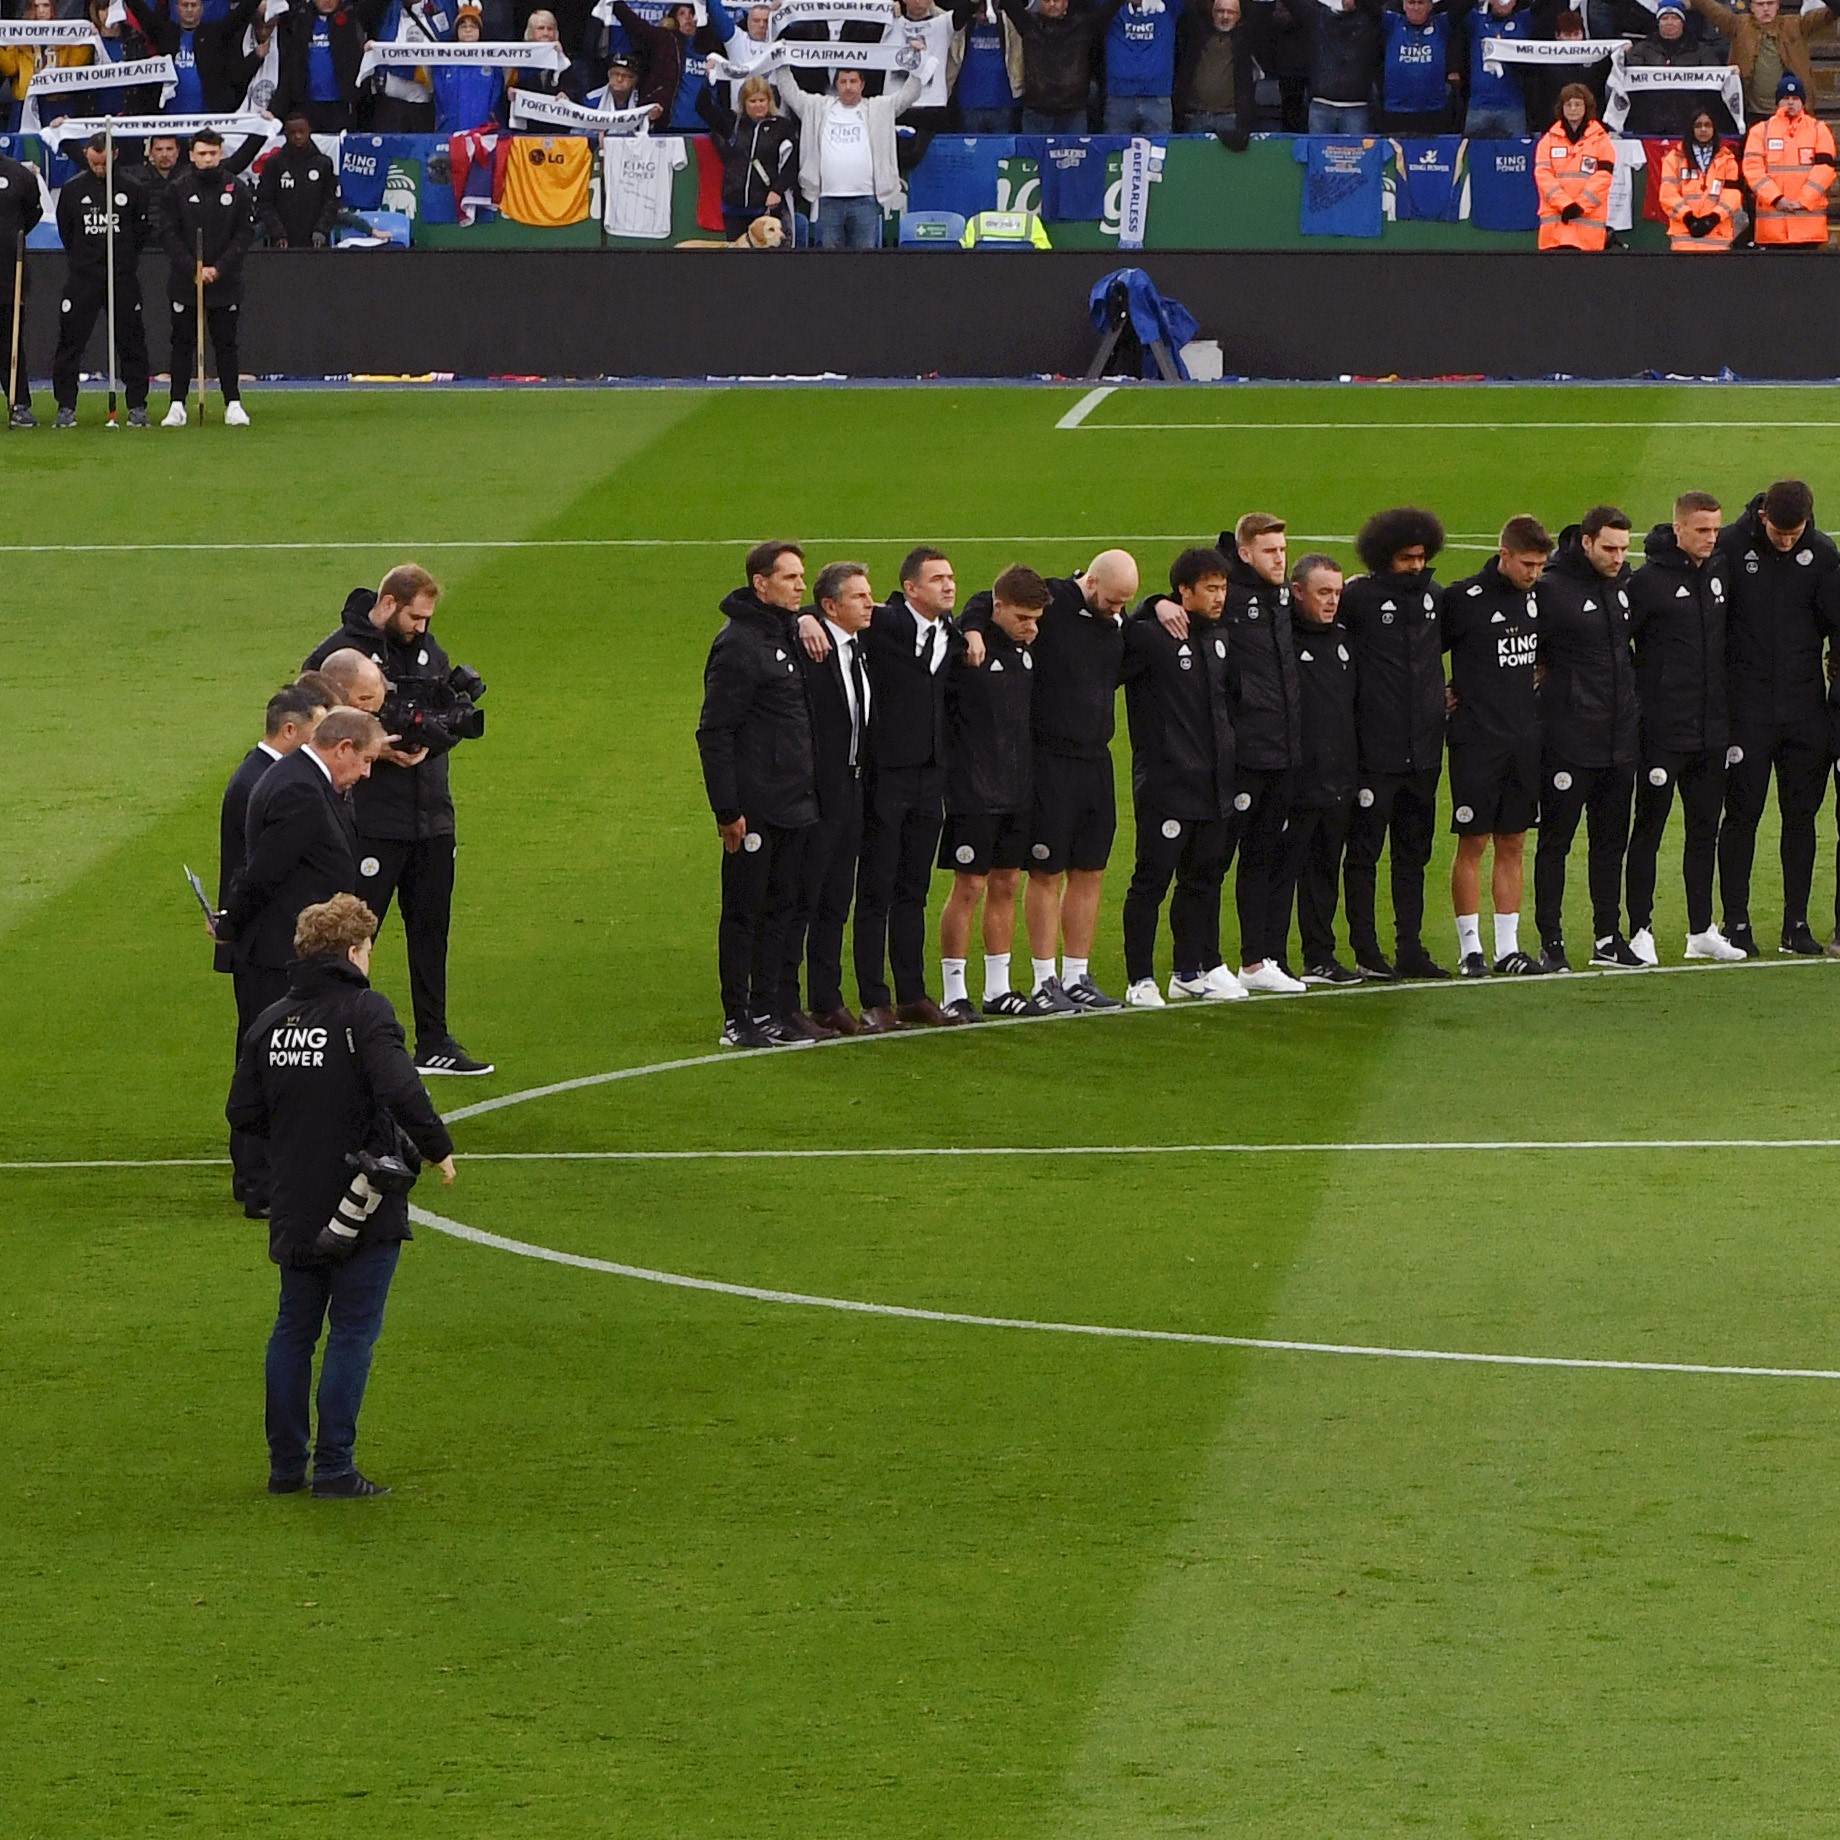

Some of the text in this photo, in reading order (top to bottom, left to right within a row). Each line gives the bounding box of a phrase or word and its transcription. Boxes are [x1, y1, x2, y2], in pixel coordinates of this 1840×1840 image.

[1125, 23, 1154, 32] KING
[382, 48, 531, 58] FOREVER IN OUR HEARTS
[791, 48, 868, 61] CHAIRMAN
[1400, 45, 1432, 56] KING
[1516, 45, 1612, 56] MR CHAIRMAN
[1399, 54, 1432, 63] POWER
[1631, 72, 1725, 83] MR CHAIRMAN
[831, 126, 860, 137] KING
[344, 153, 376, 168] KING
[548, 155, 564, 164] LG
[1496, 156, 1525, 166] KING
[343, 163, 374, 176] POWER
[624, 162, 656, 171] KING
[1496, 164, 1525, 172] POWER
[281, 179, 294, 188] TM
[1128, 141, 1142, 233] #BEFEARLESS
[1498, 633, 1538, 654] KING
[270, 1028, 328, 1049] KING
[269, 1051, 324, 1067] POWER
